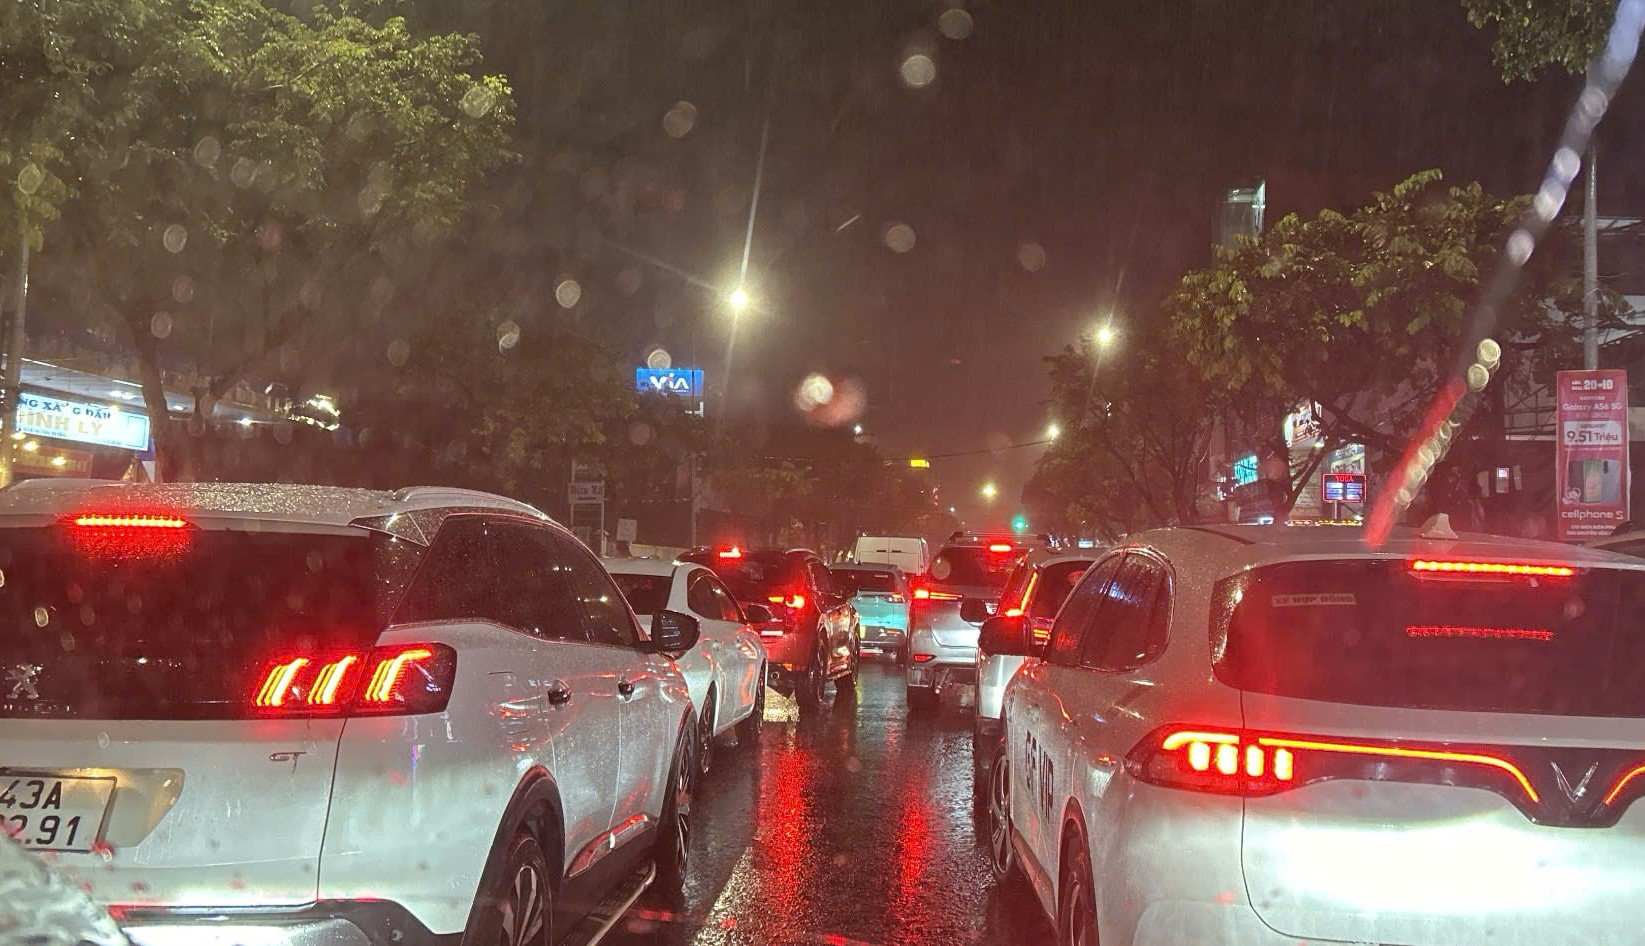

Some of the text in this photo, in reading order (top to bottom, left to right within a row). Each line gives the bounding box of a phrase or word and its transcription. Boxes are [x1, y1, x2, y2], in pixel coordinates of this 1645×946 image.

[1567, 431, 1618, 442] 9.51 Triệu
[269, 751, 307, 774] GT
[0, 780, 62, 809] 43A
[1039, 744, 1054, 824] VIP
